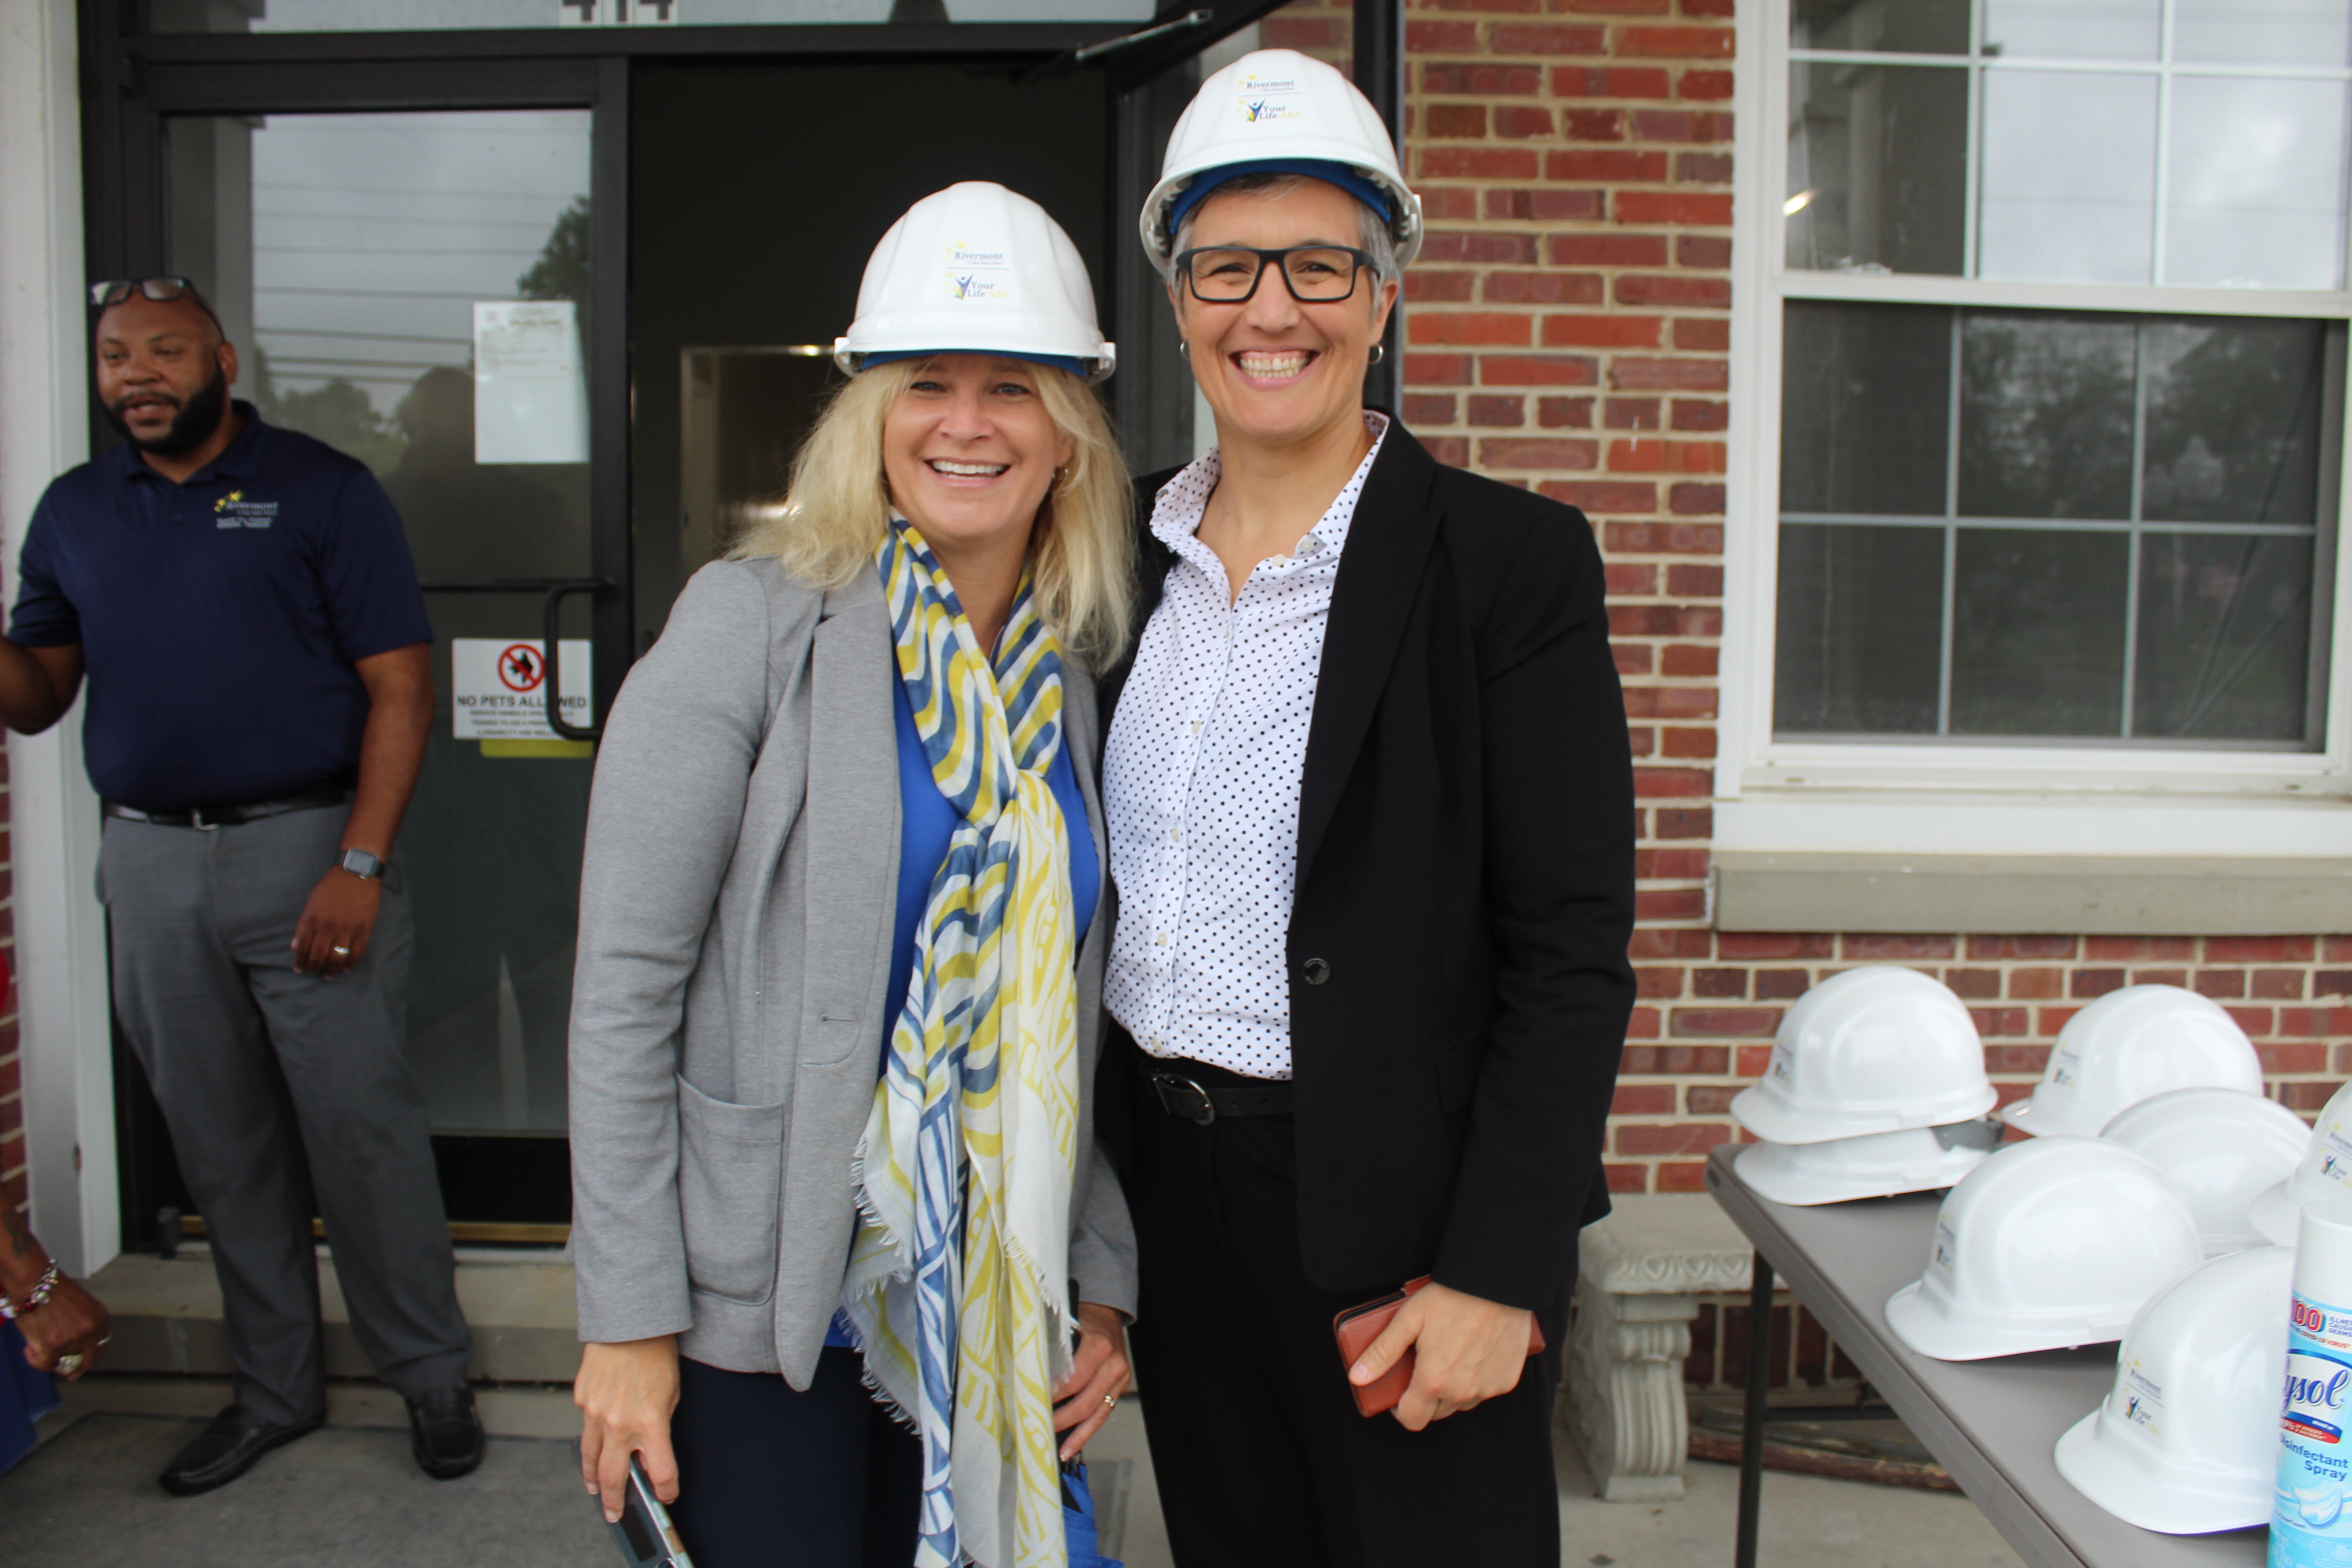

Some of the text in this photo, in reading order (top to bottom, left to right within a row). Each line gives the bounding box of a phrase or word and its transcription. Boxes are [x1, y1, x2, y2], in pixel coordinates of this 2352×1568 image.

[954, 251, 1003, 259] Rivermont
[967, 289, 1009, 298] Life ABA
[456, 696, 587, 708] NO PETS ALLWED
[2303, 1460, 2347, 1482] Spray
